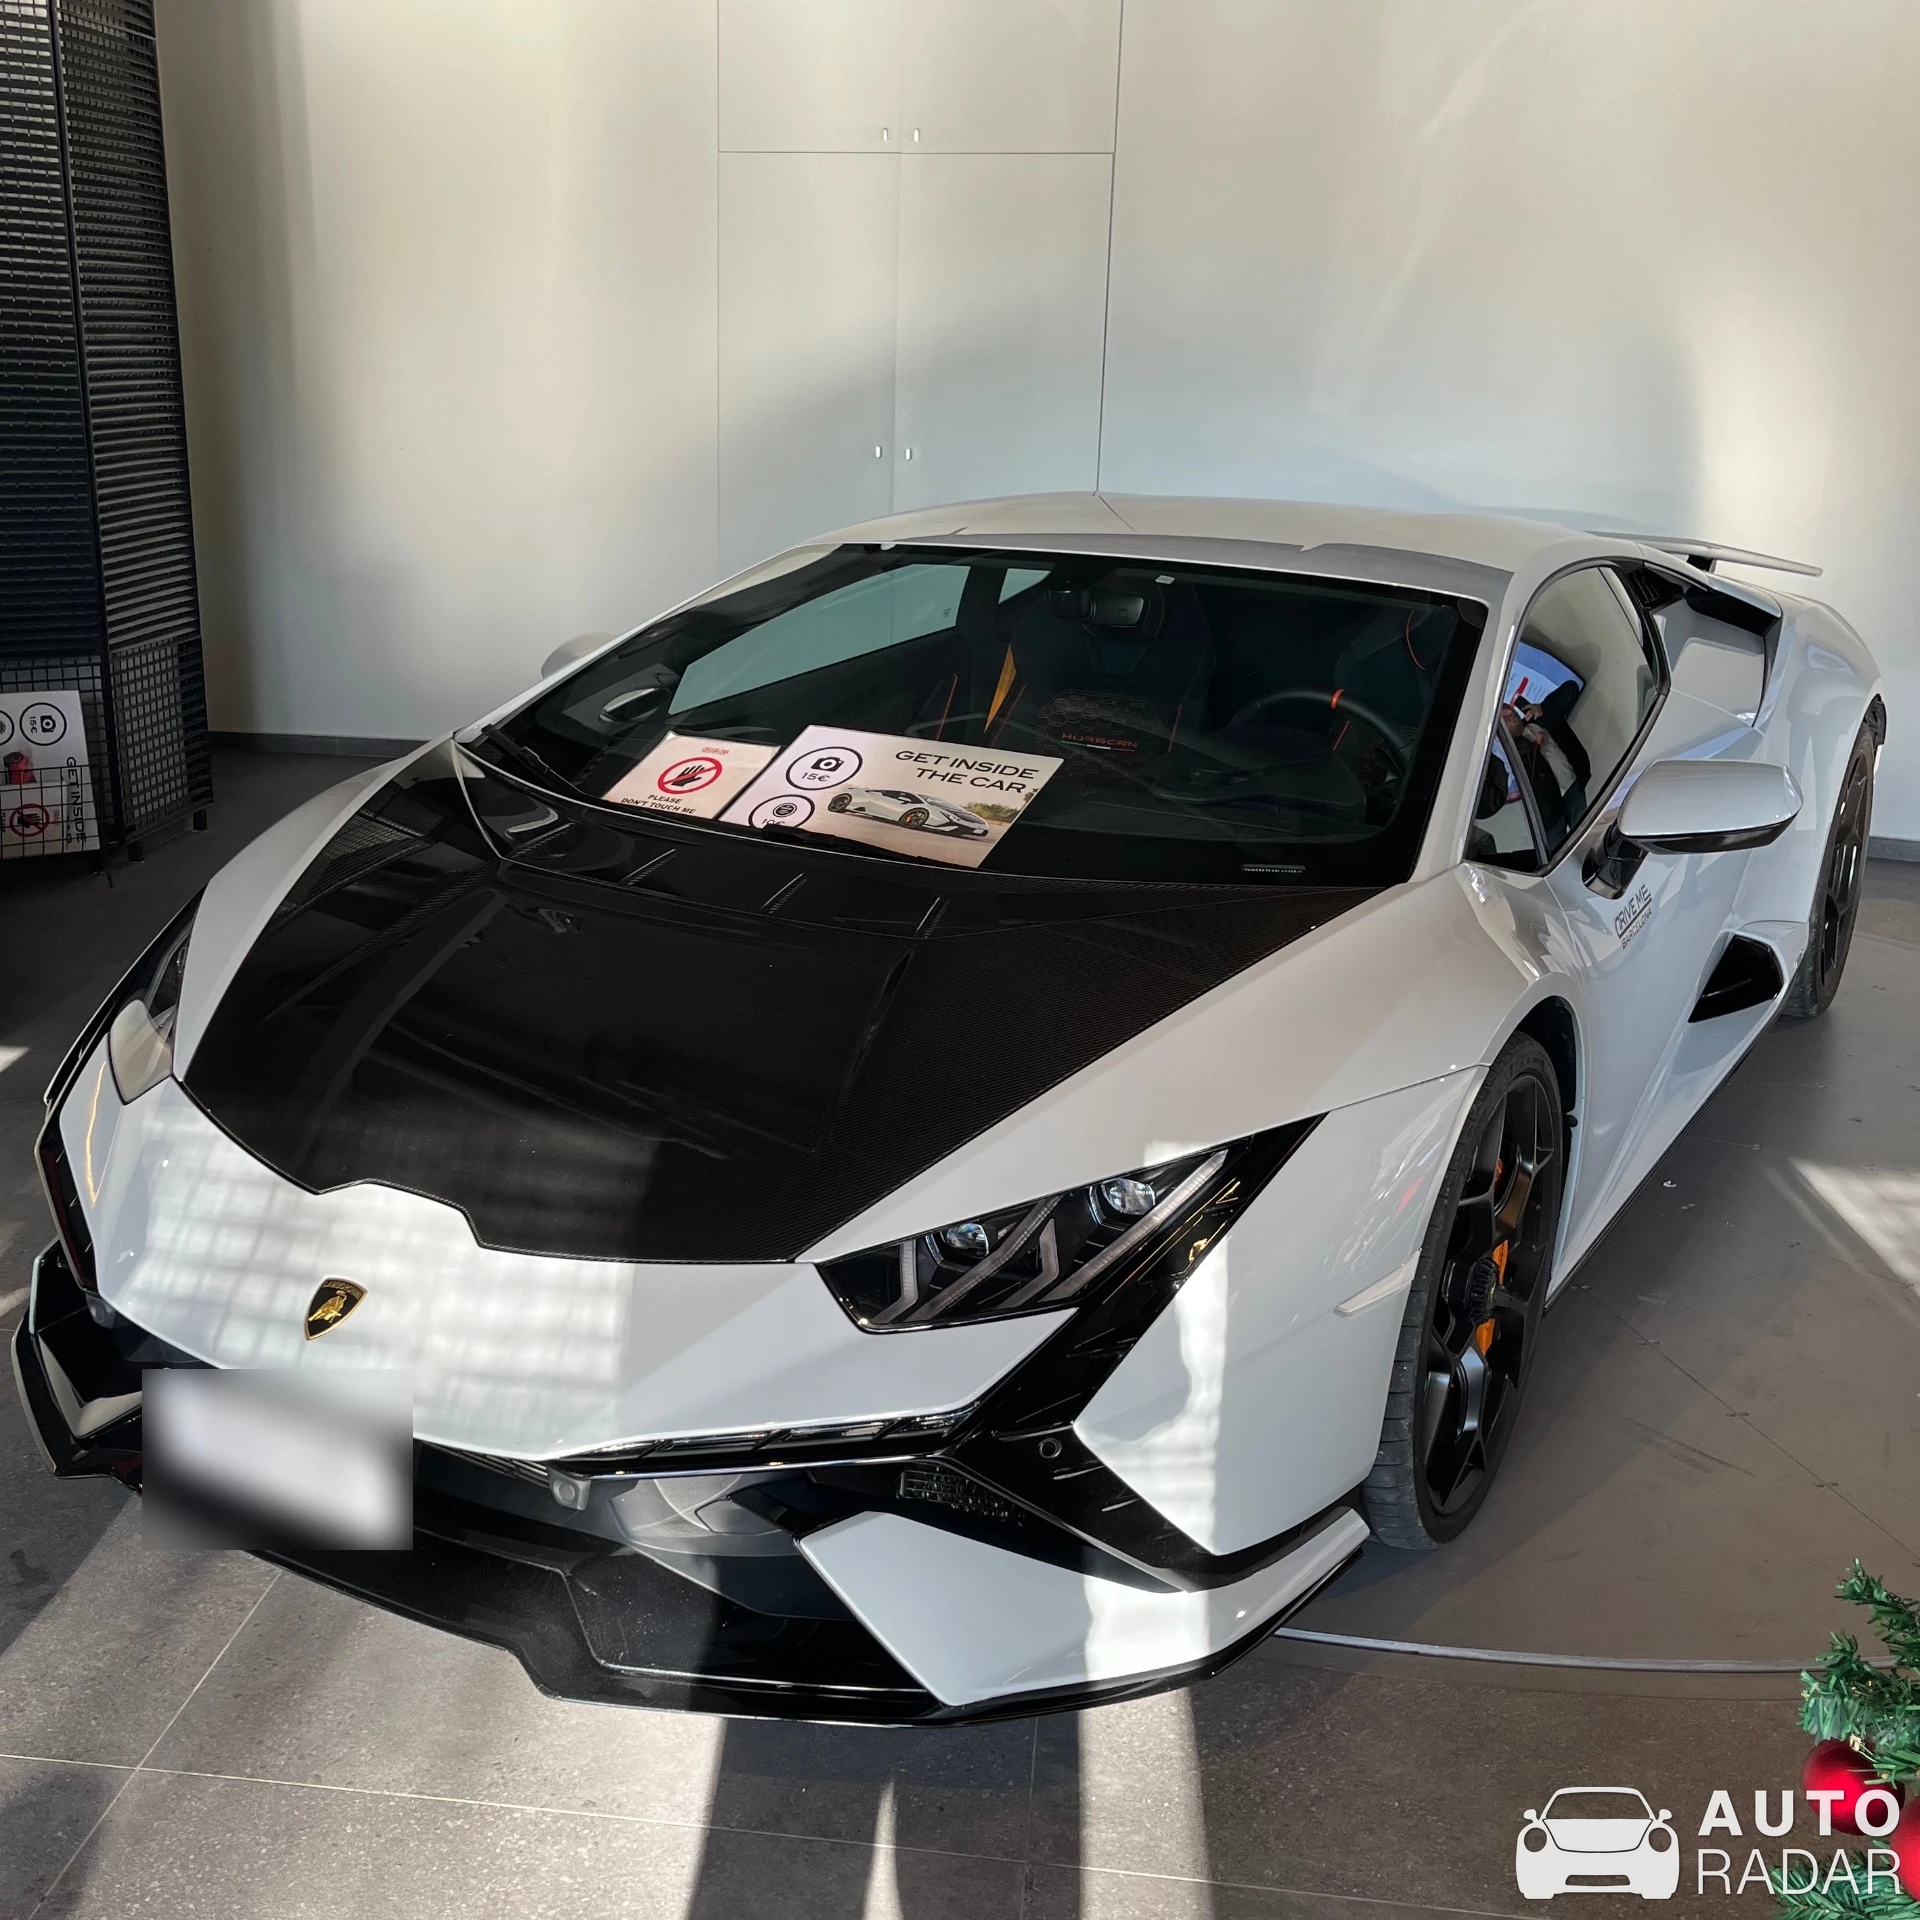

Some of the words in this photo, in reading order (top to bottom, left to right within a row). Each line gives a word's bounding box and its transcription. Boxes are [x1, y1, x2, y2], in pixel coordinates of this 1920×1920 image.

[66, 756, 80, 788] GET
[801, 772, 831, 782] 15€
[895, 750, 950, 765] GET
[950, 758, 1039, 779] INSIDE
[916, 767, 967, 784] THE
[969, 776, 1027, 793] CAR
[621, 797, 649, 807] DON'T
[650, 802, 681, 812] TOUCH
[647, 794, 683, 804] PLEASE
[70, 791, 87, 843] INSIDE
[1635, 884, 1652, 909] ME
